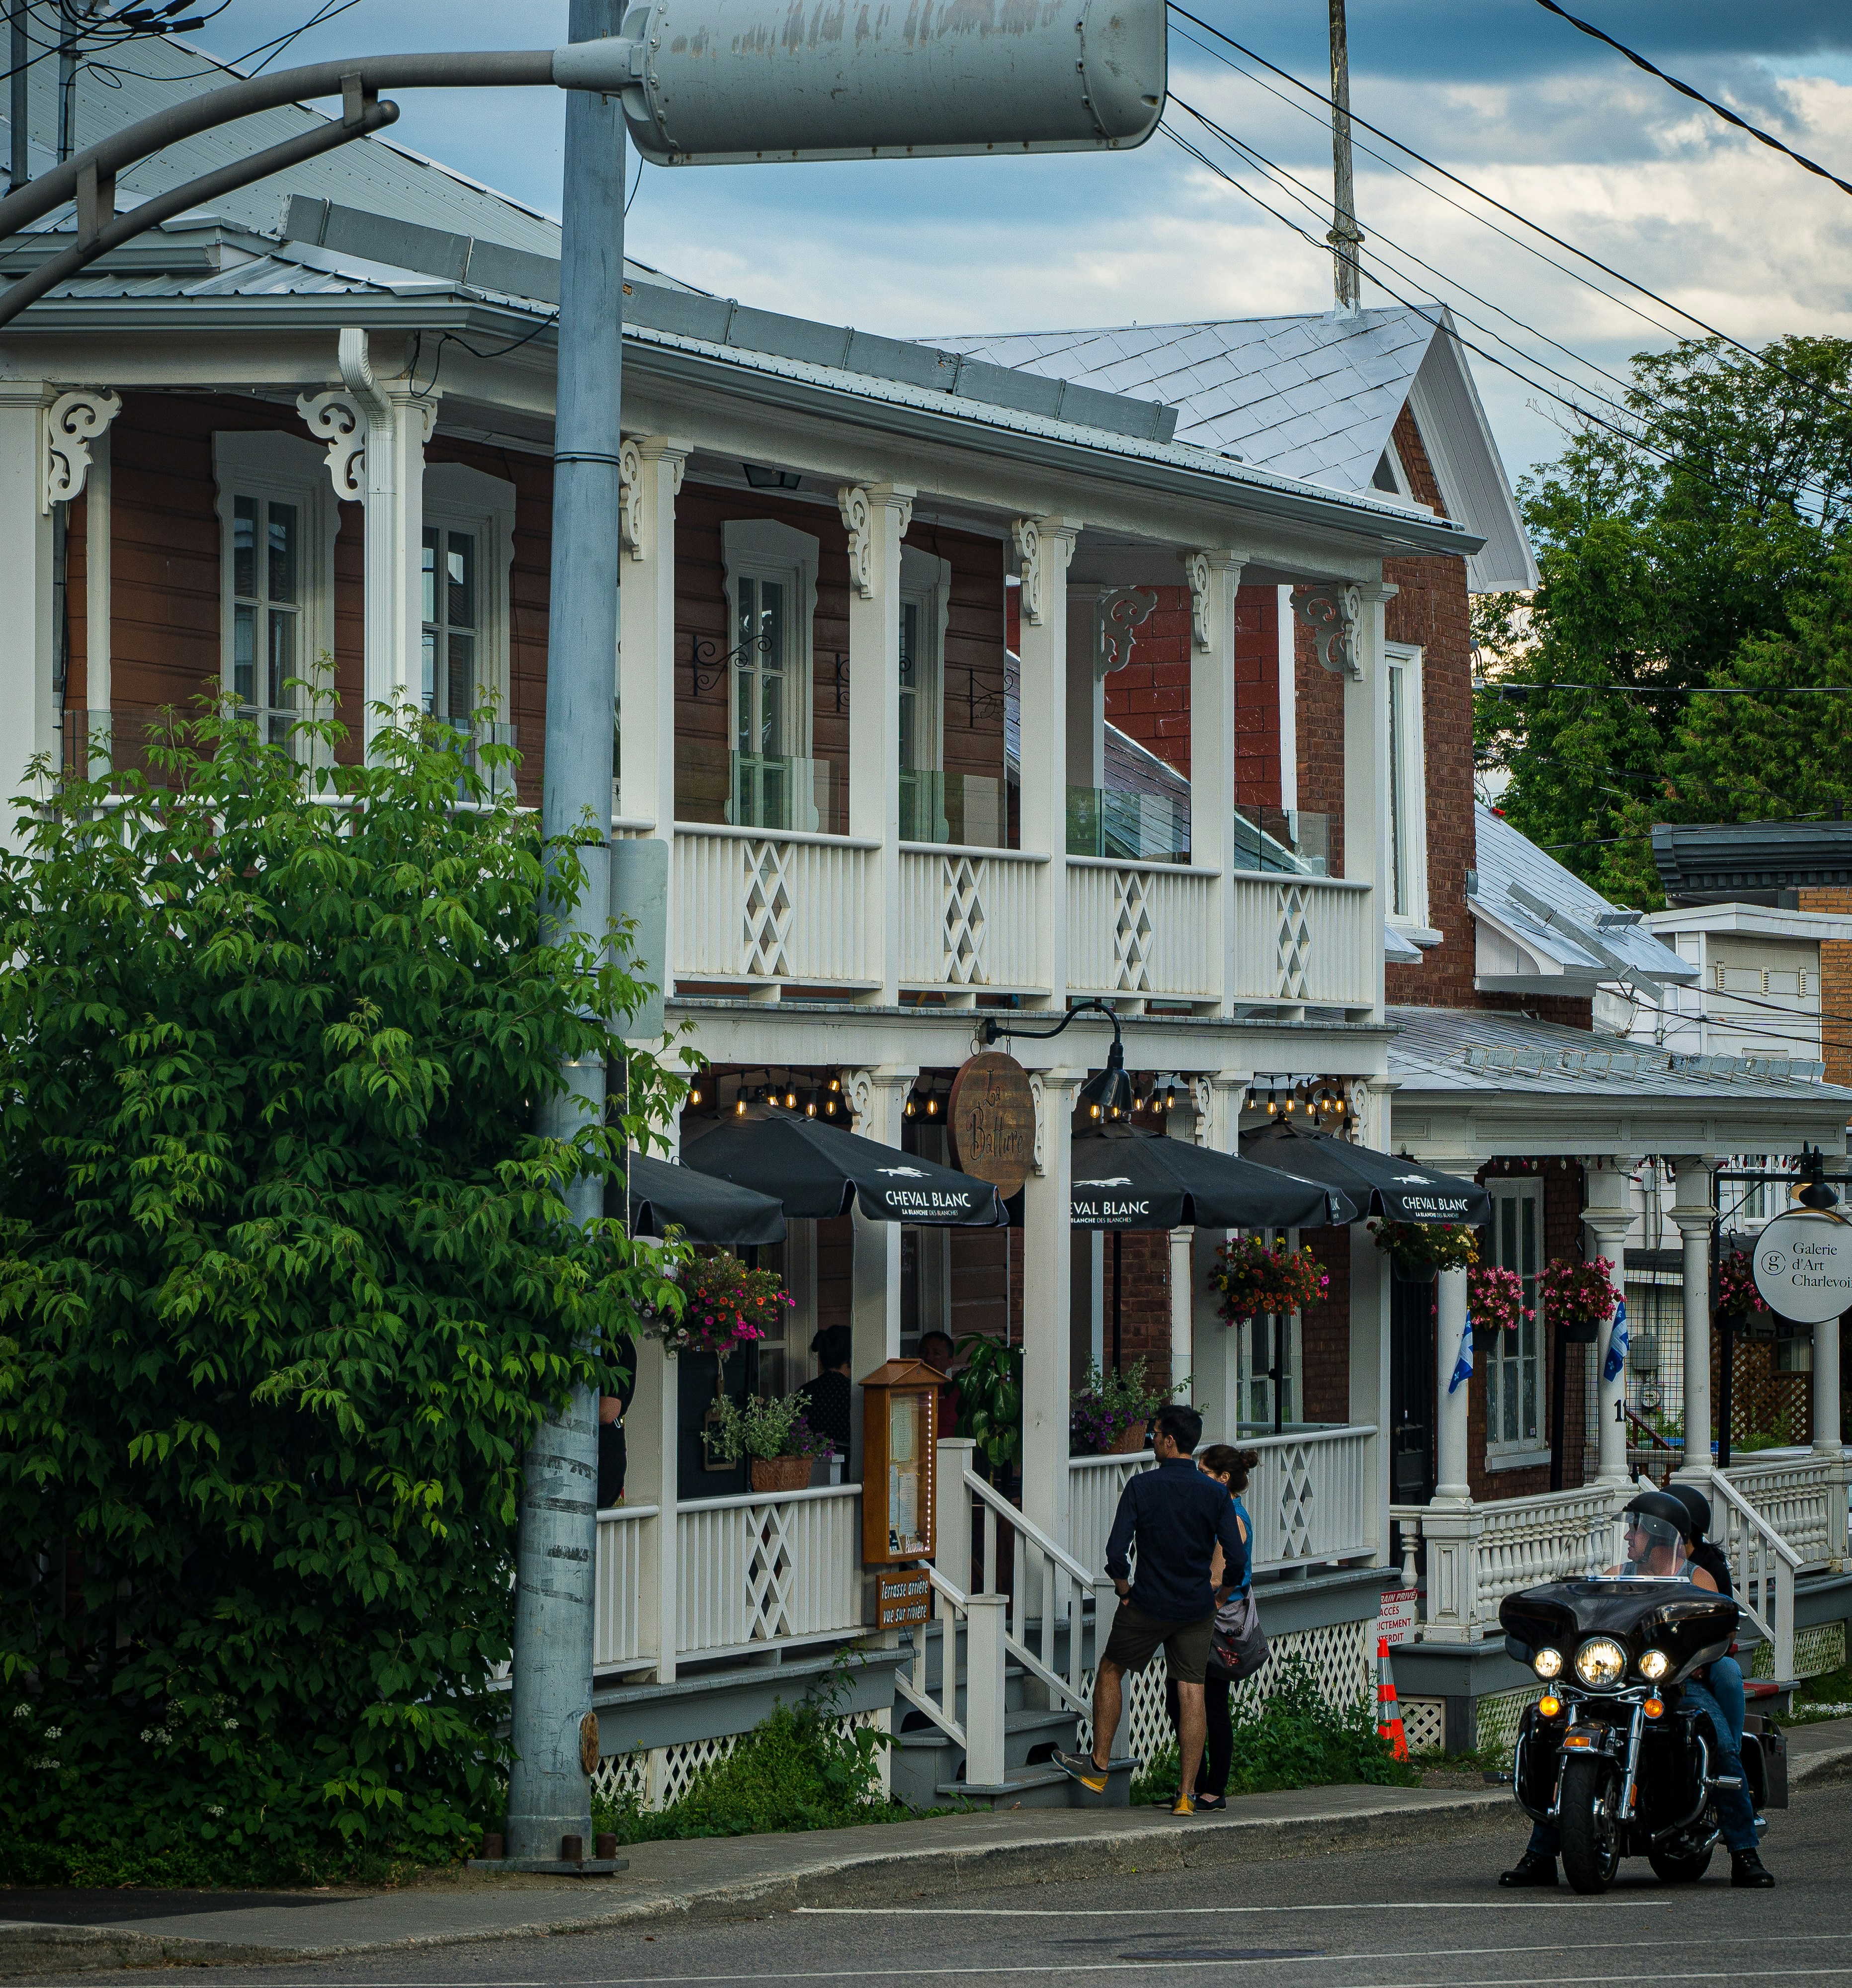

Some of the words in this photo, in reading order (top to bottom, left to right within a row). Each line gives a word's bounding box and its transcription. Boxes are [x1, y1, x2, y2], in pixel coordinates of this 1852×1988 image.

[983, 1070, 1000, 1107] La
[966, 1101, 1023, 1163] Batture
[885, 1191, 929, 1206] CHEVAL
[931, 1192, 971, 1207] BLANC
[1402, 1196, 1437, 1210] CHEVAL
[1438, 1198, 1468, 1211] BLANC
[1103, 1201, 1149, 1215] BLANC
[1792, 1242, 1838, 1255] Galerie
[1792, 1258, 1825, 1271] d'Art
[1791, 1274, 1852, 1288] Charlevoi
[882, 1581, 907, 1599] Terrasse
[908, 1574, 928, 1596] arrière
[1381, 1594, 1396, 1603] RAIN
[1396, 1590, 1416, 1601] PRIVÉ
[883, 1609, 894, 1624] vue
[895, 1608, 906, 1622] sur
[907, 1599, 926, 1620] rivière
[1380, 1604, 1399, 1616] ACCÈS
[1376, 1618, 1412, 1631] ICTEMENT
